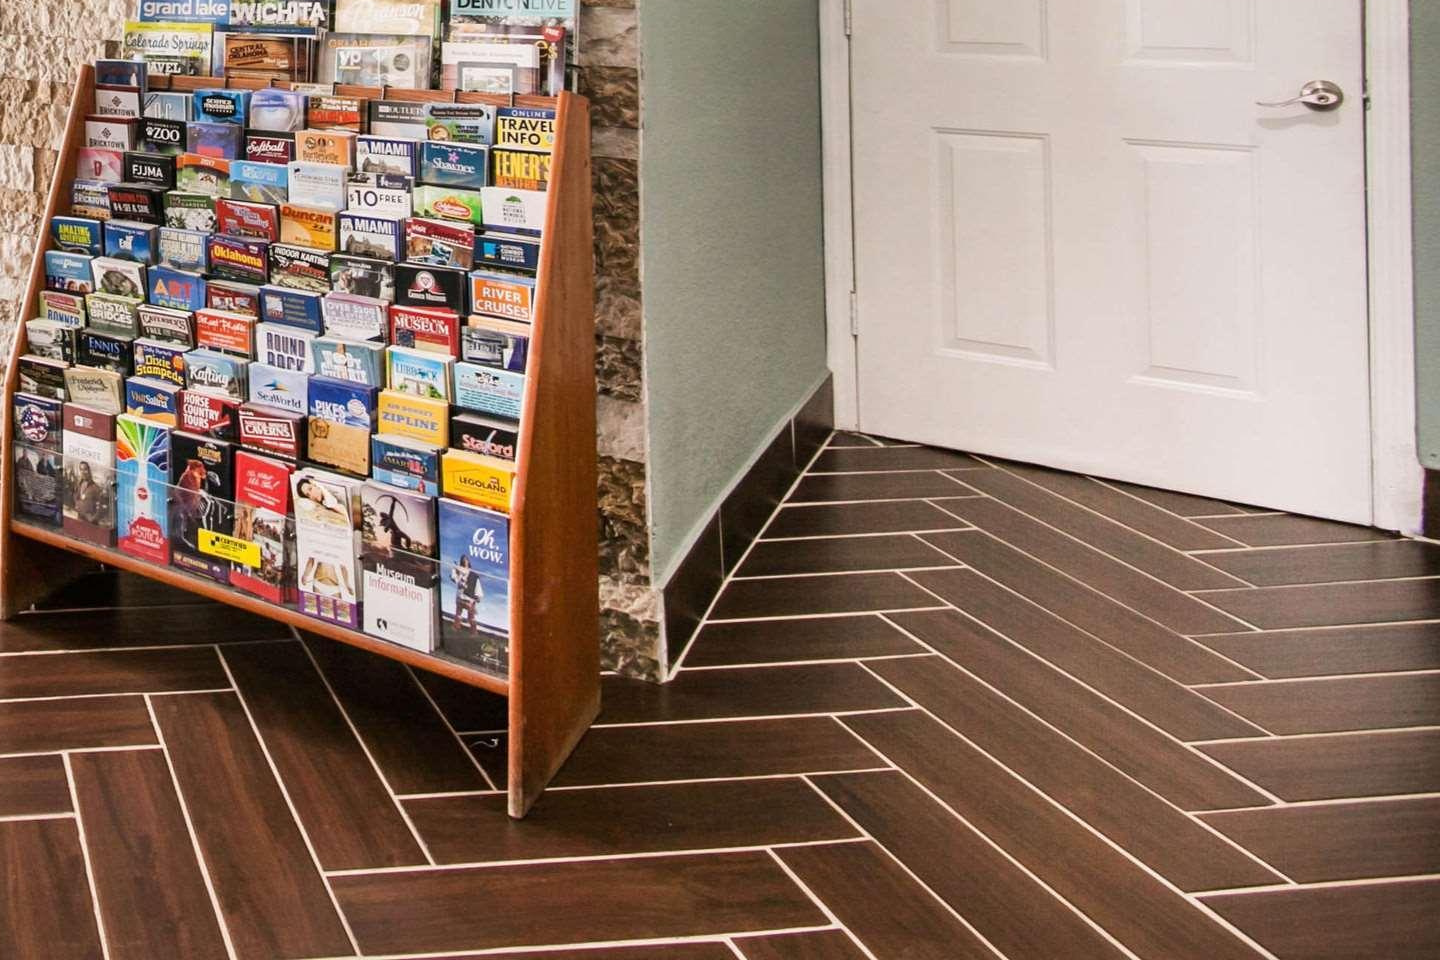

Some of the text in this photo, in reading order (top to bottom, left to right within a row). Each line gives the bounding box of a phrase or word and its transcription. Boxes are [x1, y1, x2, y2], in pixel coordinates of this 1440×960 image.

[143, 0, 228, 18] grand lake
[231, 1, 325, 22] WICHITA
[125, 32, 209, 55] Colorado Springs
[511, 109, 547, 118] ONLINE
[500, 117, 554, 133] TRAVEL
[154, 127, 180, 142] ZOO
[503, 132, 541, 146] INFO
[246, 139, 285, 157] Softball
[371, 141, 408, 156] MIAMI
[132, 164, 164, 178] FJJMA
[432, 157, 476, 175] Shawnee
[379, 194, 403, 204] FREE
[282, 206, 333, 225] Duncan
[354, 221, 392, 235] MIAMI
[214, 245, 263, 267] Oklahoma
[275, 247, 329, 267] INDOOR KARTING
[482, 287, 522, 303] RIVER
[91, 300, 129, 314] CRYSTAL
[476, 299, 529, 318] CRUISES
[91, 310, 132, 325] BRIDGES
[394, 316, 449, 336] MUSEUM
[89, 337, 121, 354] ENNIS
[266, 332, 306, 358] ROUND
[145, 353, 171, 368] Dixie
[136, 365, 184, 385] Stampede
[184, 391, 210, 408] HORSE
[257, 391, 301, 409] SeaWorld
[183, 403, 219, 421] COUNTRY
[315, 400, 345, 419] PIKES
[184, 413, 209, 428] TOURS
[383, 411, 439, 432] ZIPLINE
[245, 424, 291, 437] CAVERNS
[459, 476, 506, 493] LEGOLAND
[376, 563, 415, 585] Museum
